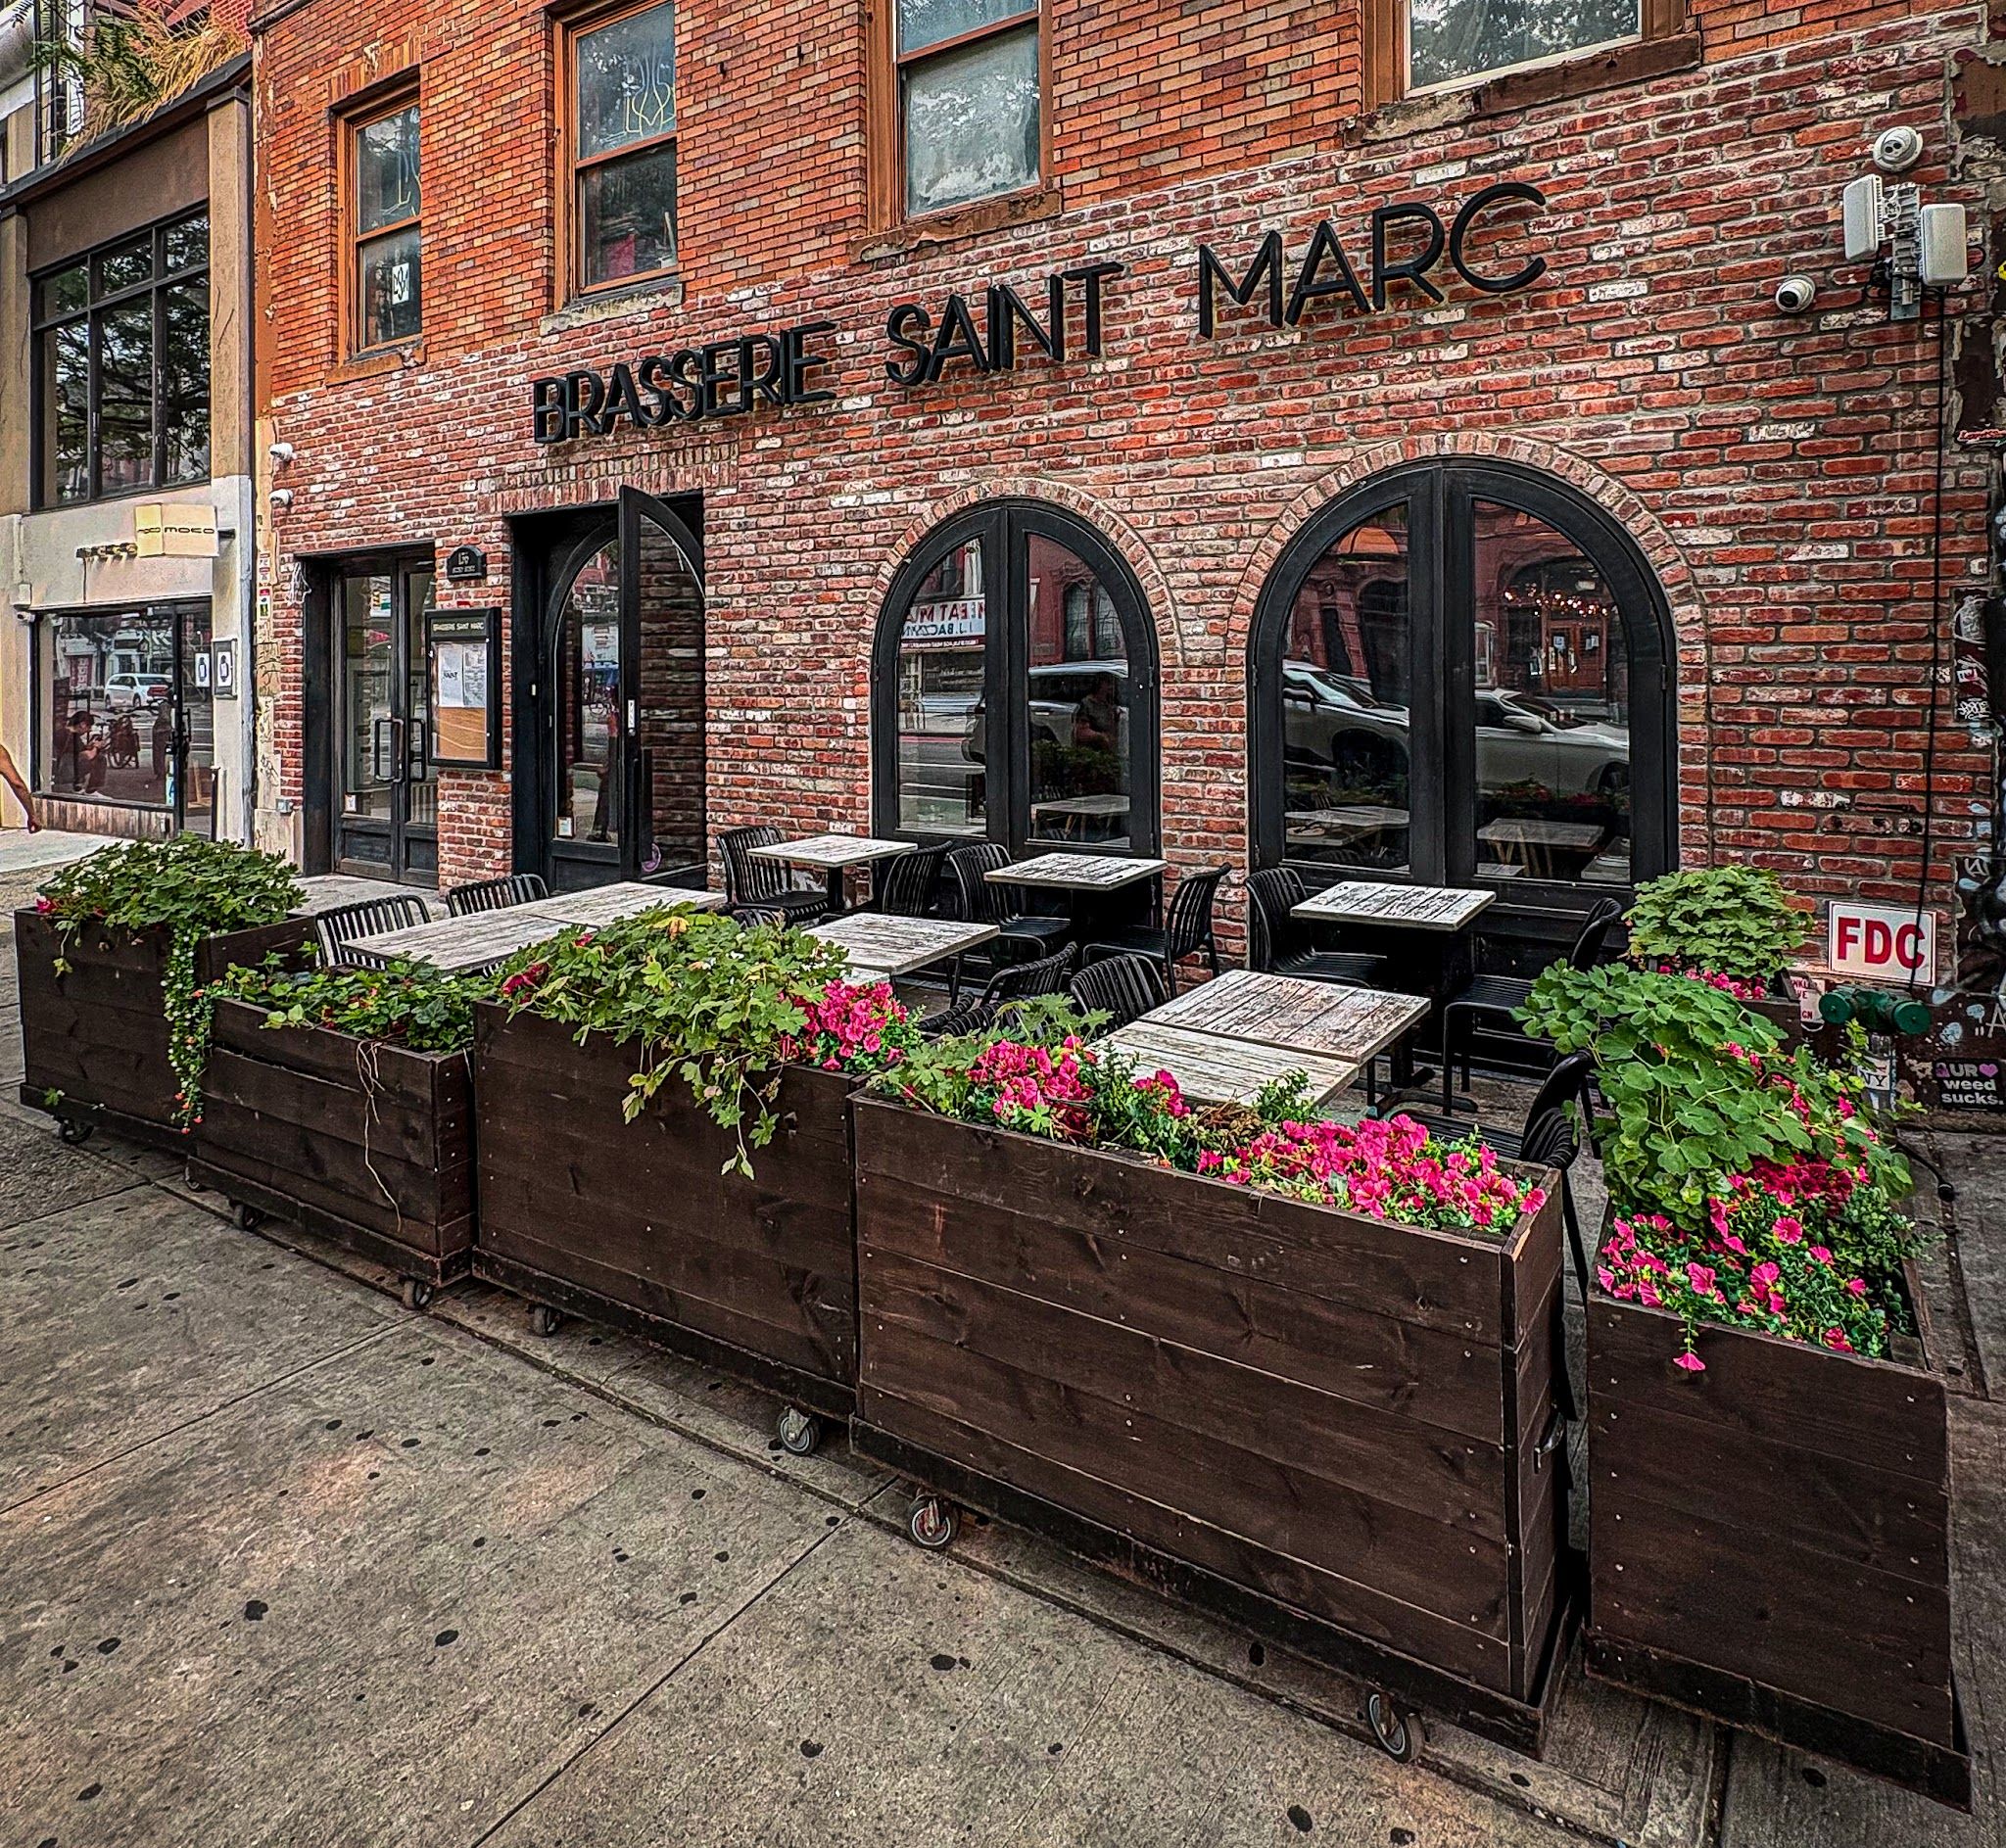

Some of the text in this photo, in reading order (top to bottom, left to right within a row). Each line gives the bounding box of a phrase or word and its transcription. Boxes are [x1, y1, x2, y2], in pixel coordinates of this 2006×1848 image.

[533, 181, 1547, 444] BRASSERIE SAINT MARC
[1838, 916, 1926, 970] FDC
[1941, 1092, 2004, 1106] sucks.
[1943, 1079, 1997, 1091] weed
